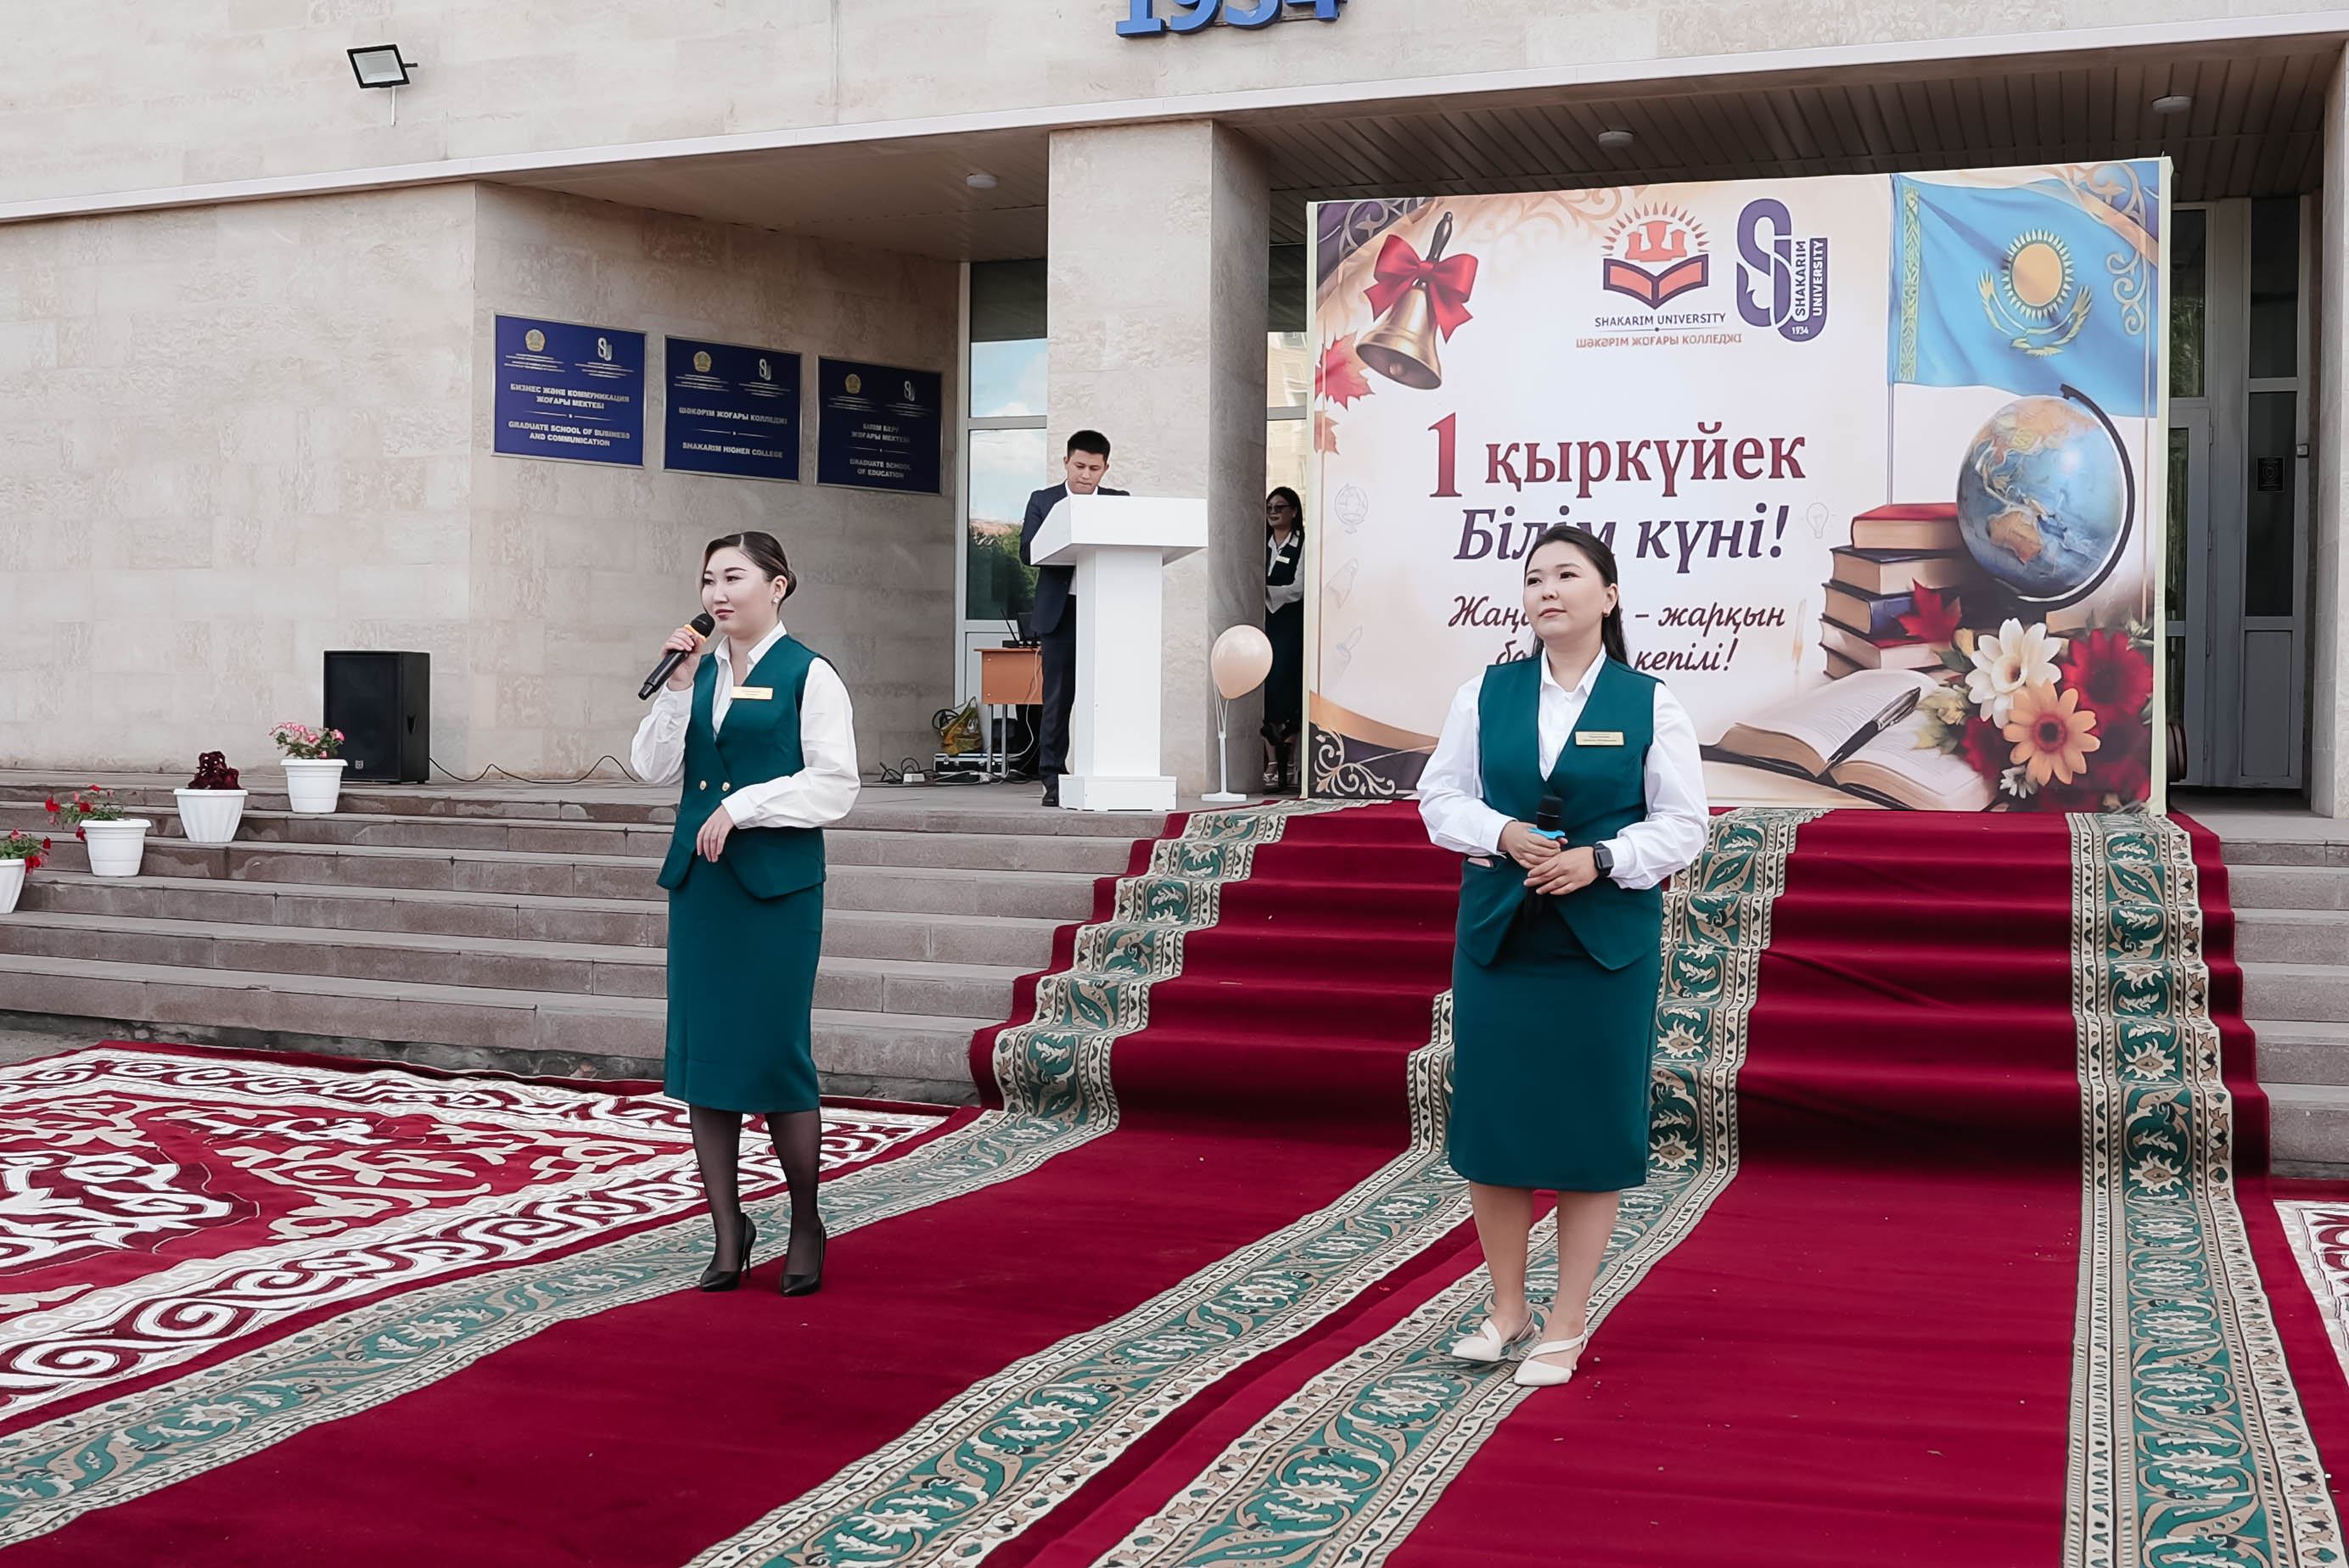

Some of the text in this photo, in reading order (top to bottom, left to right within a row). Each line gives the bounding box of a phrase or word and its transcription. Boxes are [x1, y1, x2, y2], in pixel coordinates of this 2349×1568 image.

[1795, 240, 1806, 316] SHAKARIM
[1812, 239, 1824, 316] UNIVERSITY
[1595, 312, 1726, 328] SHAKARIM UNIVERSITY
[1791, 326, 1809, 335] 1934
[1576, 333, 1742, 348] ШӘКӘРІМ ЖОҒАРЫ КОЛЛЕДЖІ
[510, 383, 541, 394] БИЗНЕС
[508, 421, 548, 431] GRADUATE
[551, 425, 580, 434] SCHOOL
[594, 428, 631, 440] BUSINESS
[547, 434, 610, 446] COMMUNICATION
[682, 441, 783, 459] SHAKARIM HIGHER COLLEGE
[1428, 412, 1806, 499] 1 қыркүйек
[849, 458, 911, 470] GRADUATE SCHOOL
[867, 469, 905, 479] EDUCATION
[1635, 503, 1790, 574] күні!
[1657, 602, 1786, 637] жарқын
[1634, 637, 1739, 671] кепілі!
